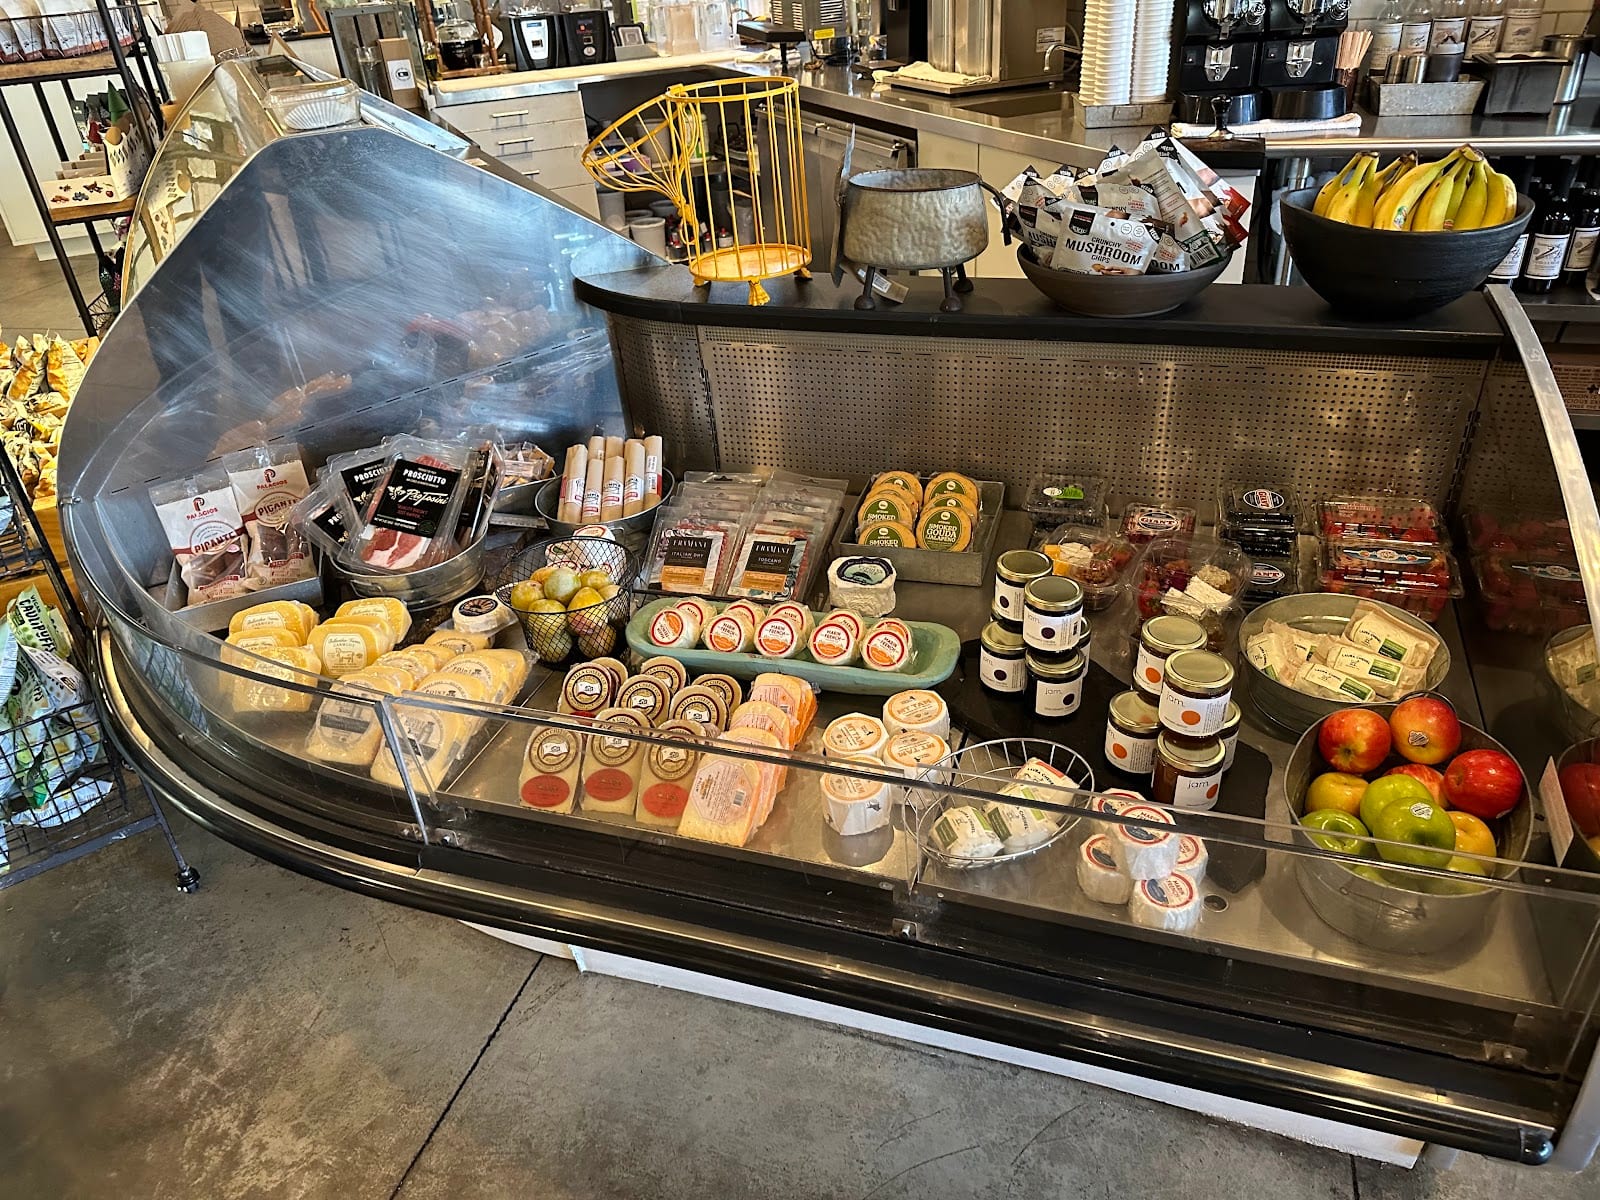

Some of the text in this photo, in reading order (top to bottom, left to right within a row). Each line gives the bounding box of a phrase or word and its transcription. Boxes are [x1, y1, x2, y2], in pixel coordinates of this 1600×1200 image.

[1091, 237, 1122, 248] CRUNCHY
[1065, 238, 1142, 265] MUSHROOM
[1091, 254, 1110, 264] CHIPS
[402, 468, 447, 485] PROSCIUTTO
[257, 479, 288, 491] PALACIOS
[867, 513, 896, 521] SMOKED
[1140, 517, 1176, 525] GIANT
[929, 523, 958, 532] SMOKED
[926, 528, 957, 538] GOUDA
[911, 699, 932, 709] TAM
